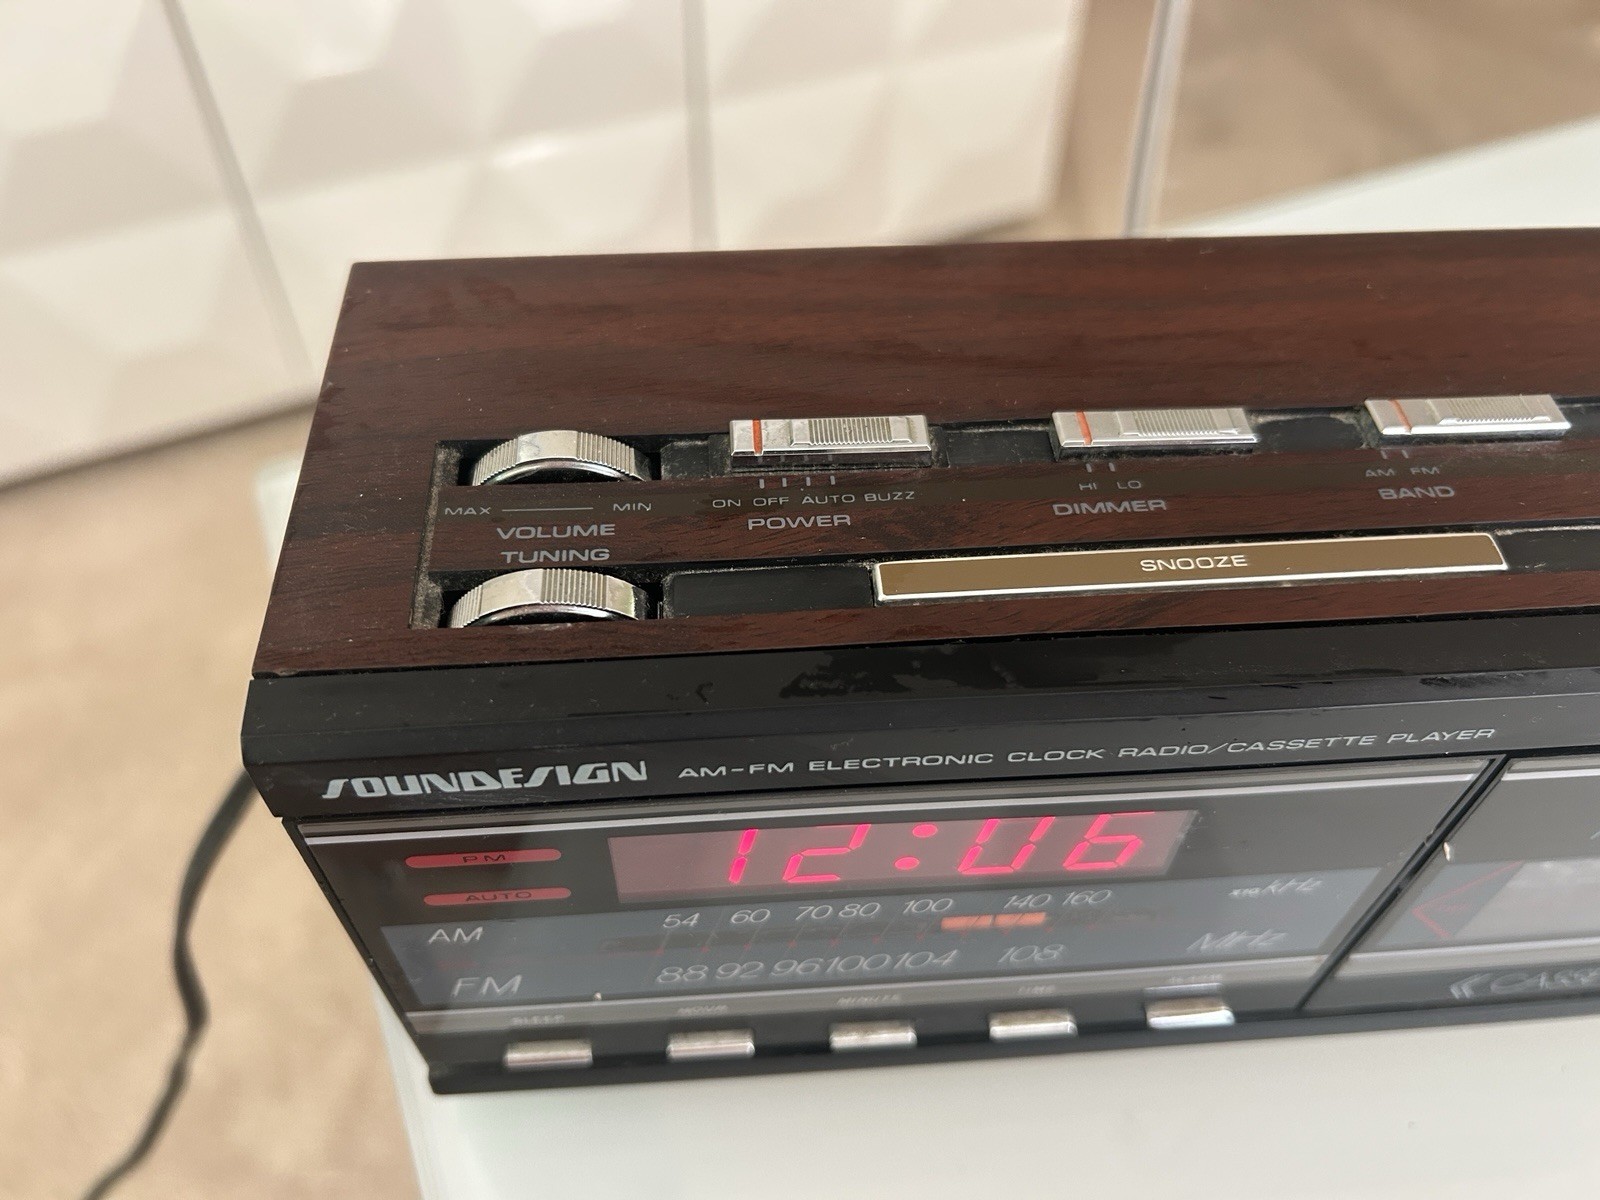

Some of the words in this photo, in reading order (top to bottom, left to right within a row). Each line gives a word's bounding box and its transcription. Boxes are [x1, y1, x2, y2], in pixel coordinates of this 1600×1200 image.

[1364, 468, 1396, 478] AM
[1410, 466, 1441, 476] FM
[1078, 482, 1098, 492] HI
[1116, 480, 1143, 491] LO
[1377, 485, 1456, 501] BAND
[711, 498, 742, 510] ON
[752, 496, 790, 508] OFF
[801, 493, 857, 506] AUTO
[864, 490, 916, 503] BUZZ
[1051, 499, 1168, 517] DIMMER
[444, 506, 492, 517] MAX
[612, 502, 653, 513] MIN
[496, 522, 617, 539] VOLUME
[747, 513, 852, 531] POWER
[500, 547, 612, 564] TUNING
[1139, 554, 1249, 573] SNOOZE
[677, 762, 796, 779] AM-FM
[807, 751, 996, 772] ELECTRONIC
[1006, 747, 1106, 764] CLOCK
[1117, 734, 1379, 759] RADIO/CASSETTE
[1386, 728, 1498, 745] PLAYER
[321, 759, 649, 800] SOUNDESIGN
[728, 810, 1156, 885] 12:06
[461, 853, 507, 864] PM
[465, 891, 533, 902] AUTO
[427, 925, 485, 945] AM
[662, 911, 701, 929] 54
[730, 907, 772, 925] 60
[795, 904, 834, 921] 70
[838, 901, 882, 919] 80
[902, 898, 954, 915] 100
[1002, 893, 1052, 909] 140
[1062, 889, 1114, 906] 160
[451, 973, 523, 998] FM
[655, 964, 710, 984] 88
[715, 961, 765, 980] 92
[769, 957, 826, 977] 96
[826, 952, 893, 974] 100
[893, 949, 960, 970] 104
[998, 943, 1068, 964] 108
